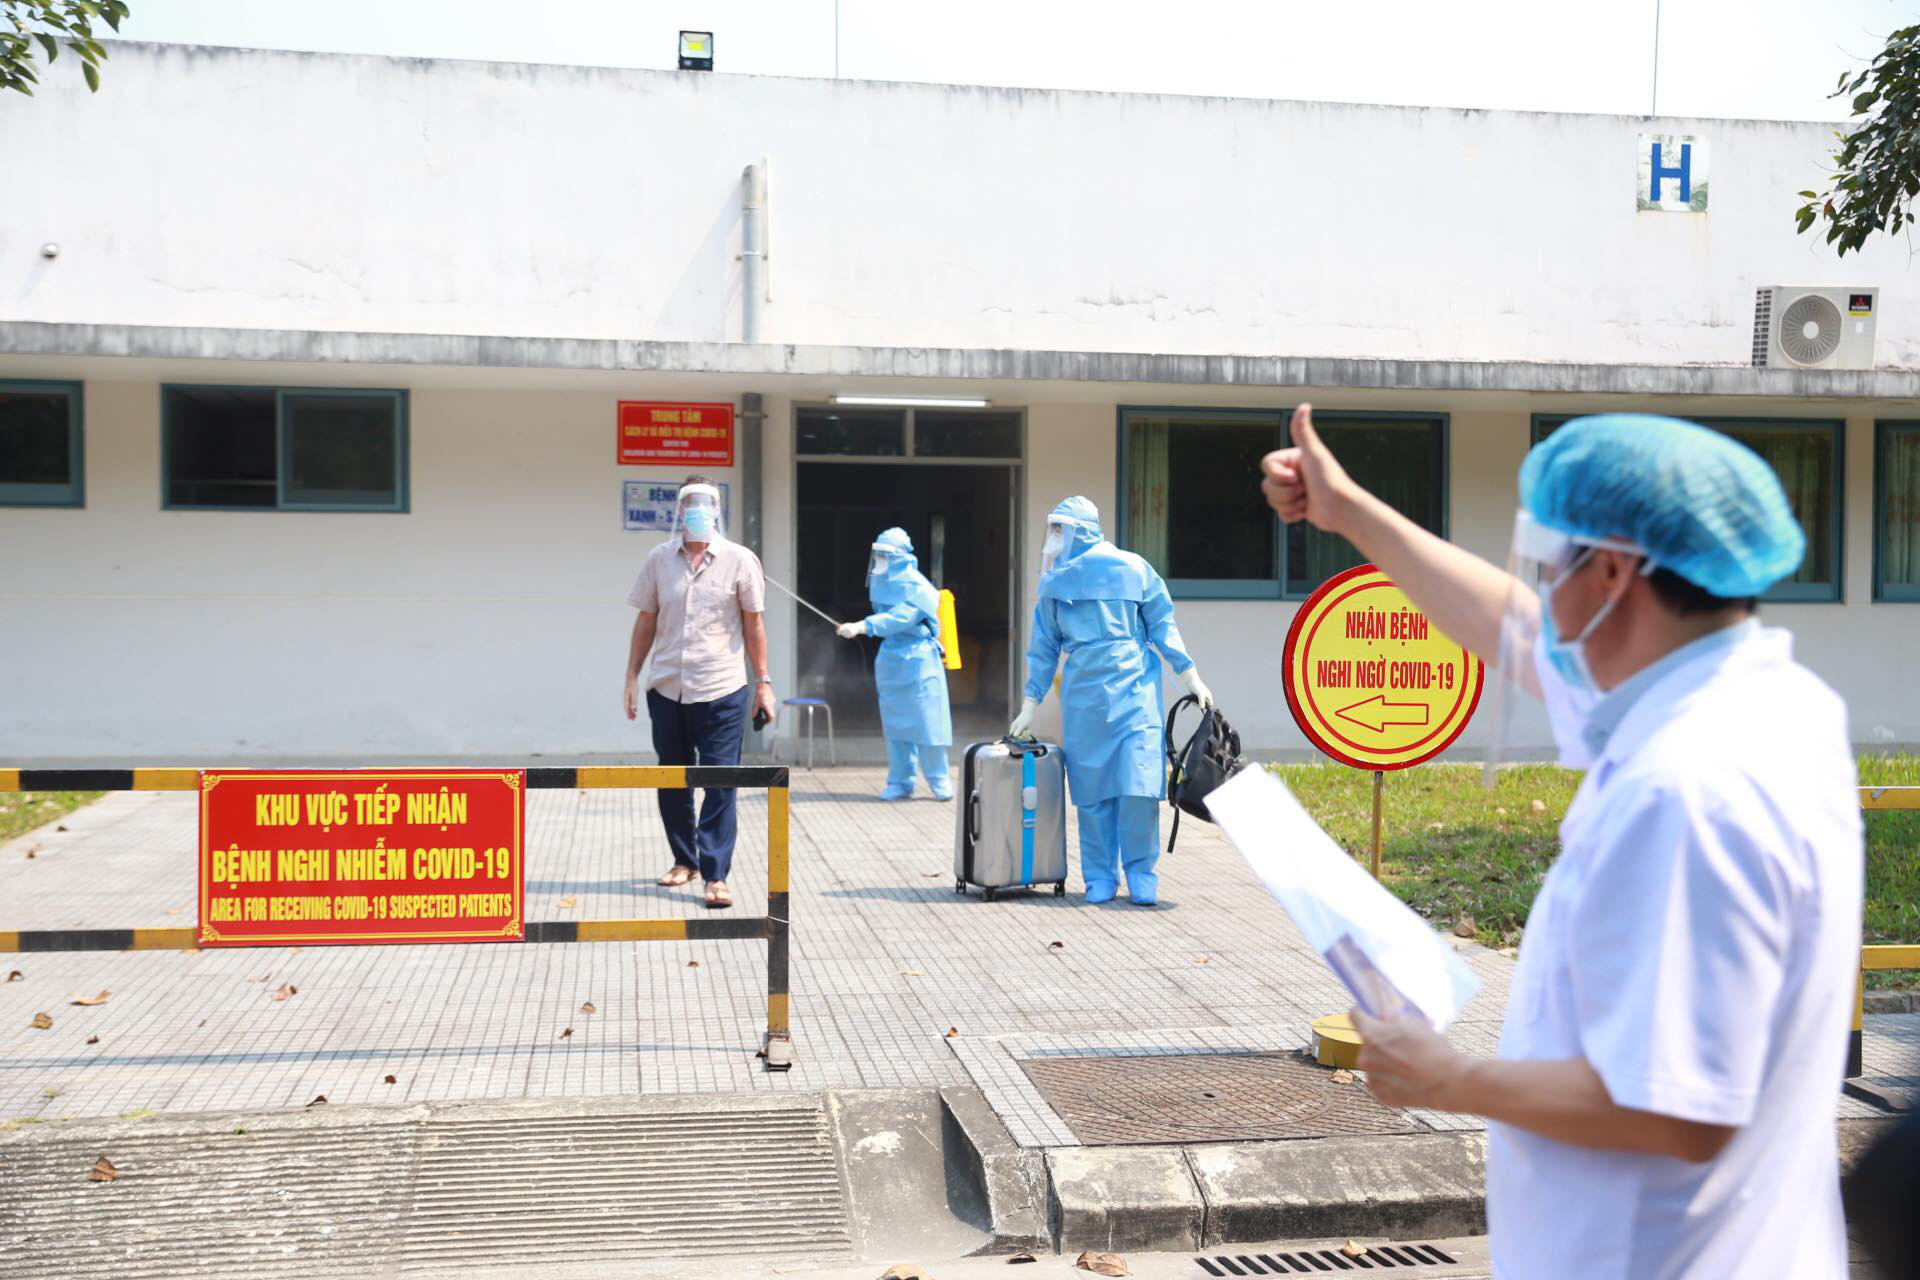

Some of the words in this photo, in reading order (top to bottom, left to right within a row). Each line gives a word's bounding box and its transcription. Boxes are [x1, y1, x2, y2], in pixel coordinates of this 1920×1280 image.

[1650, 143, 1691, 202] H
[648, 487, 677, 504] BỆNH
[628, 510, 657, 522] XANH
[1345, 605, 1386, 645] NHẬN
[1390, 606, 1428, 646] BỆNH
[1317, 660, 1351, 688] NGHI
[1356, 654, 1386, 689] NGỜ
[1390, 661, 1454, 689] COVID-19
[256, 794, 300, 826] KHU
[306, 790, 348, 832] VỰC
[354, 783, 401, 825] TIẾP
[407, 786, 467, 831] NHẬN
[212, 843, 271, 890] BỆNH
[277, 849, 330, 881] NGHI
[336, 837, 407, 881] NHIỄM
[413, 847, 510, 880] COVID-19
[210, 898, 242, 921] AREA
[244, 897, 267, 921] FOR
[270, 896, 331, 921] RECEIVING
[334, 895, 387, 920] COVID-19
[390, 894, 456, 919] SUSPECTED
[459, 893, 512, 918] PATIENTS
